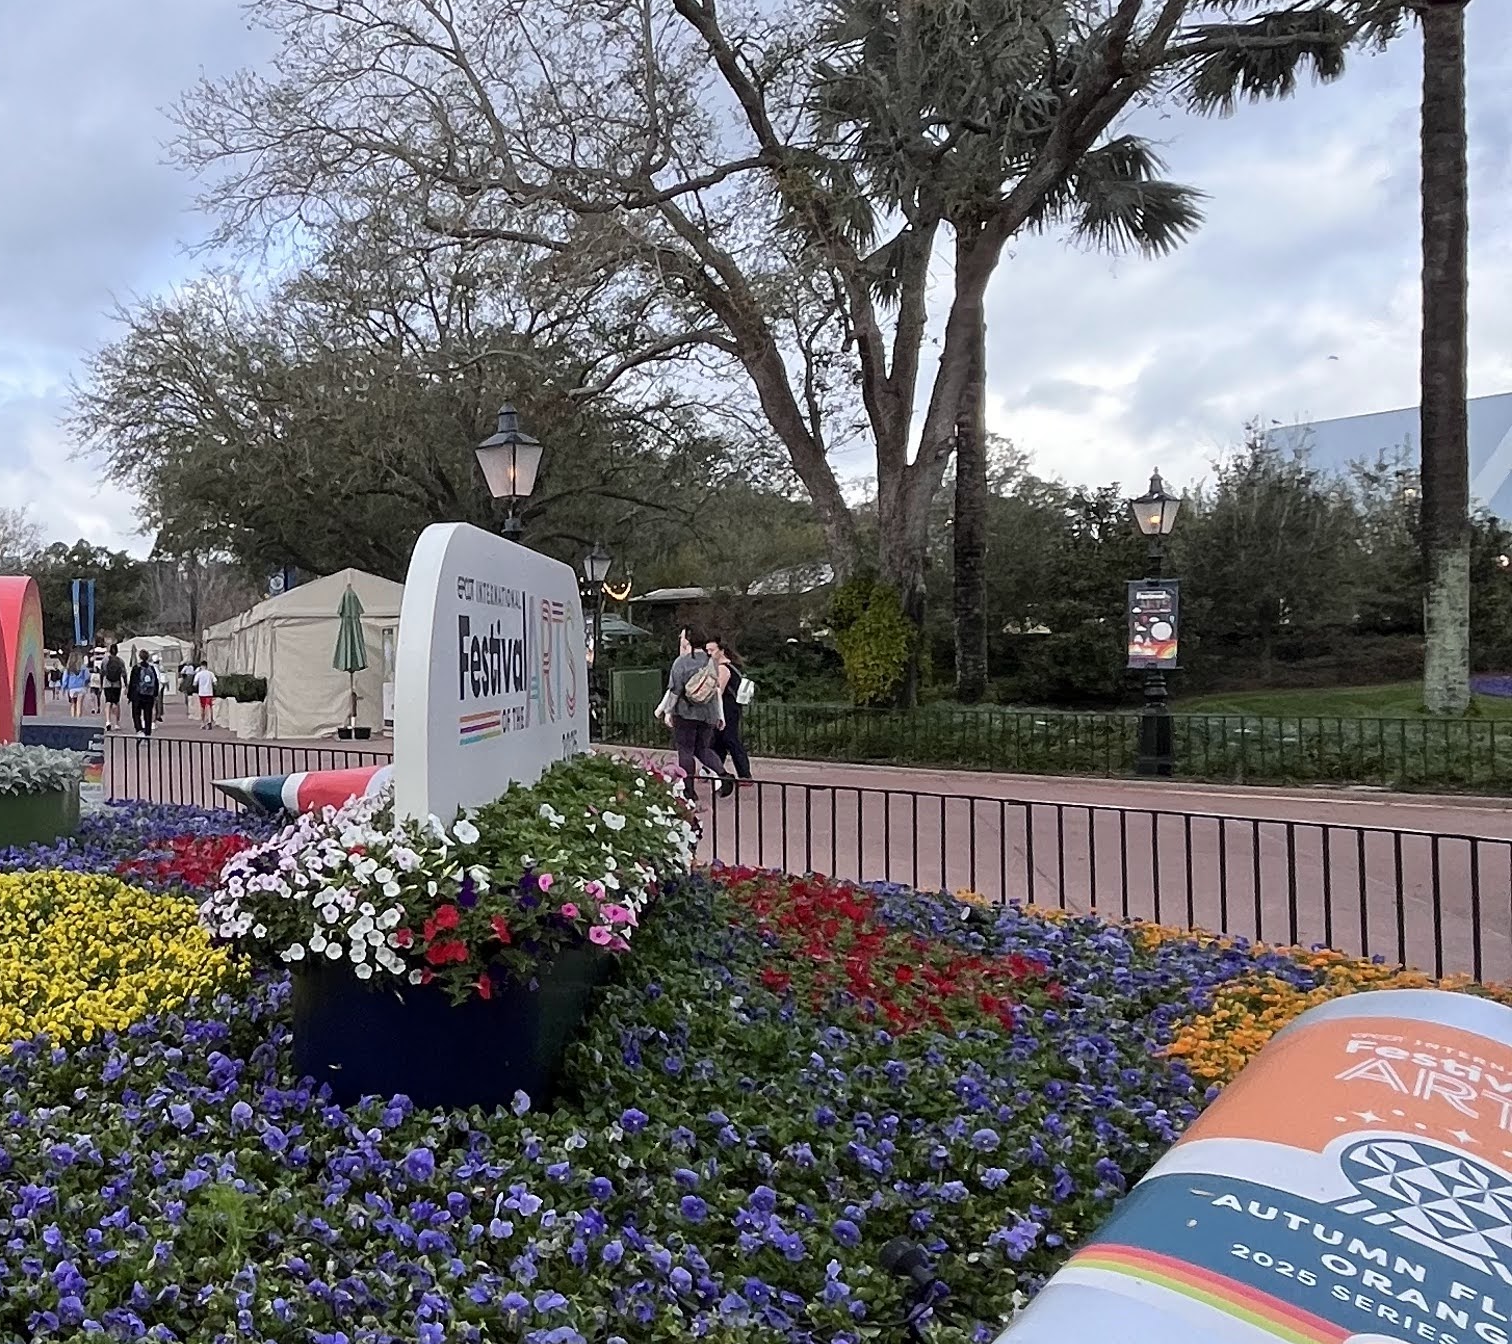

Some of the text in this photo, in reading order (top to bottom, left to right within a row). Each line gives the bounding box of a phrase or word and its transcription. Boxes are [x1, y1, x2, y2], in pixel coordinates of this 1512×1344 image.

[458, 590, 527, 700] Festival
[525, 596, 576, 728] ARTS
[1413, 1039, 1512, 1076] INTERN
[1211, 1194, 1512, 1323] AUTUMN FL
[1231, 1243, 1317, 1287] 2025
